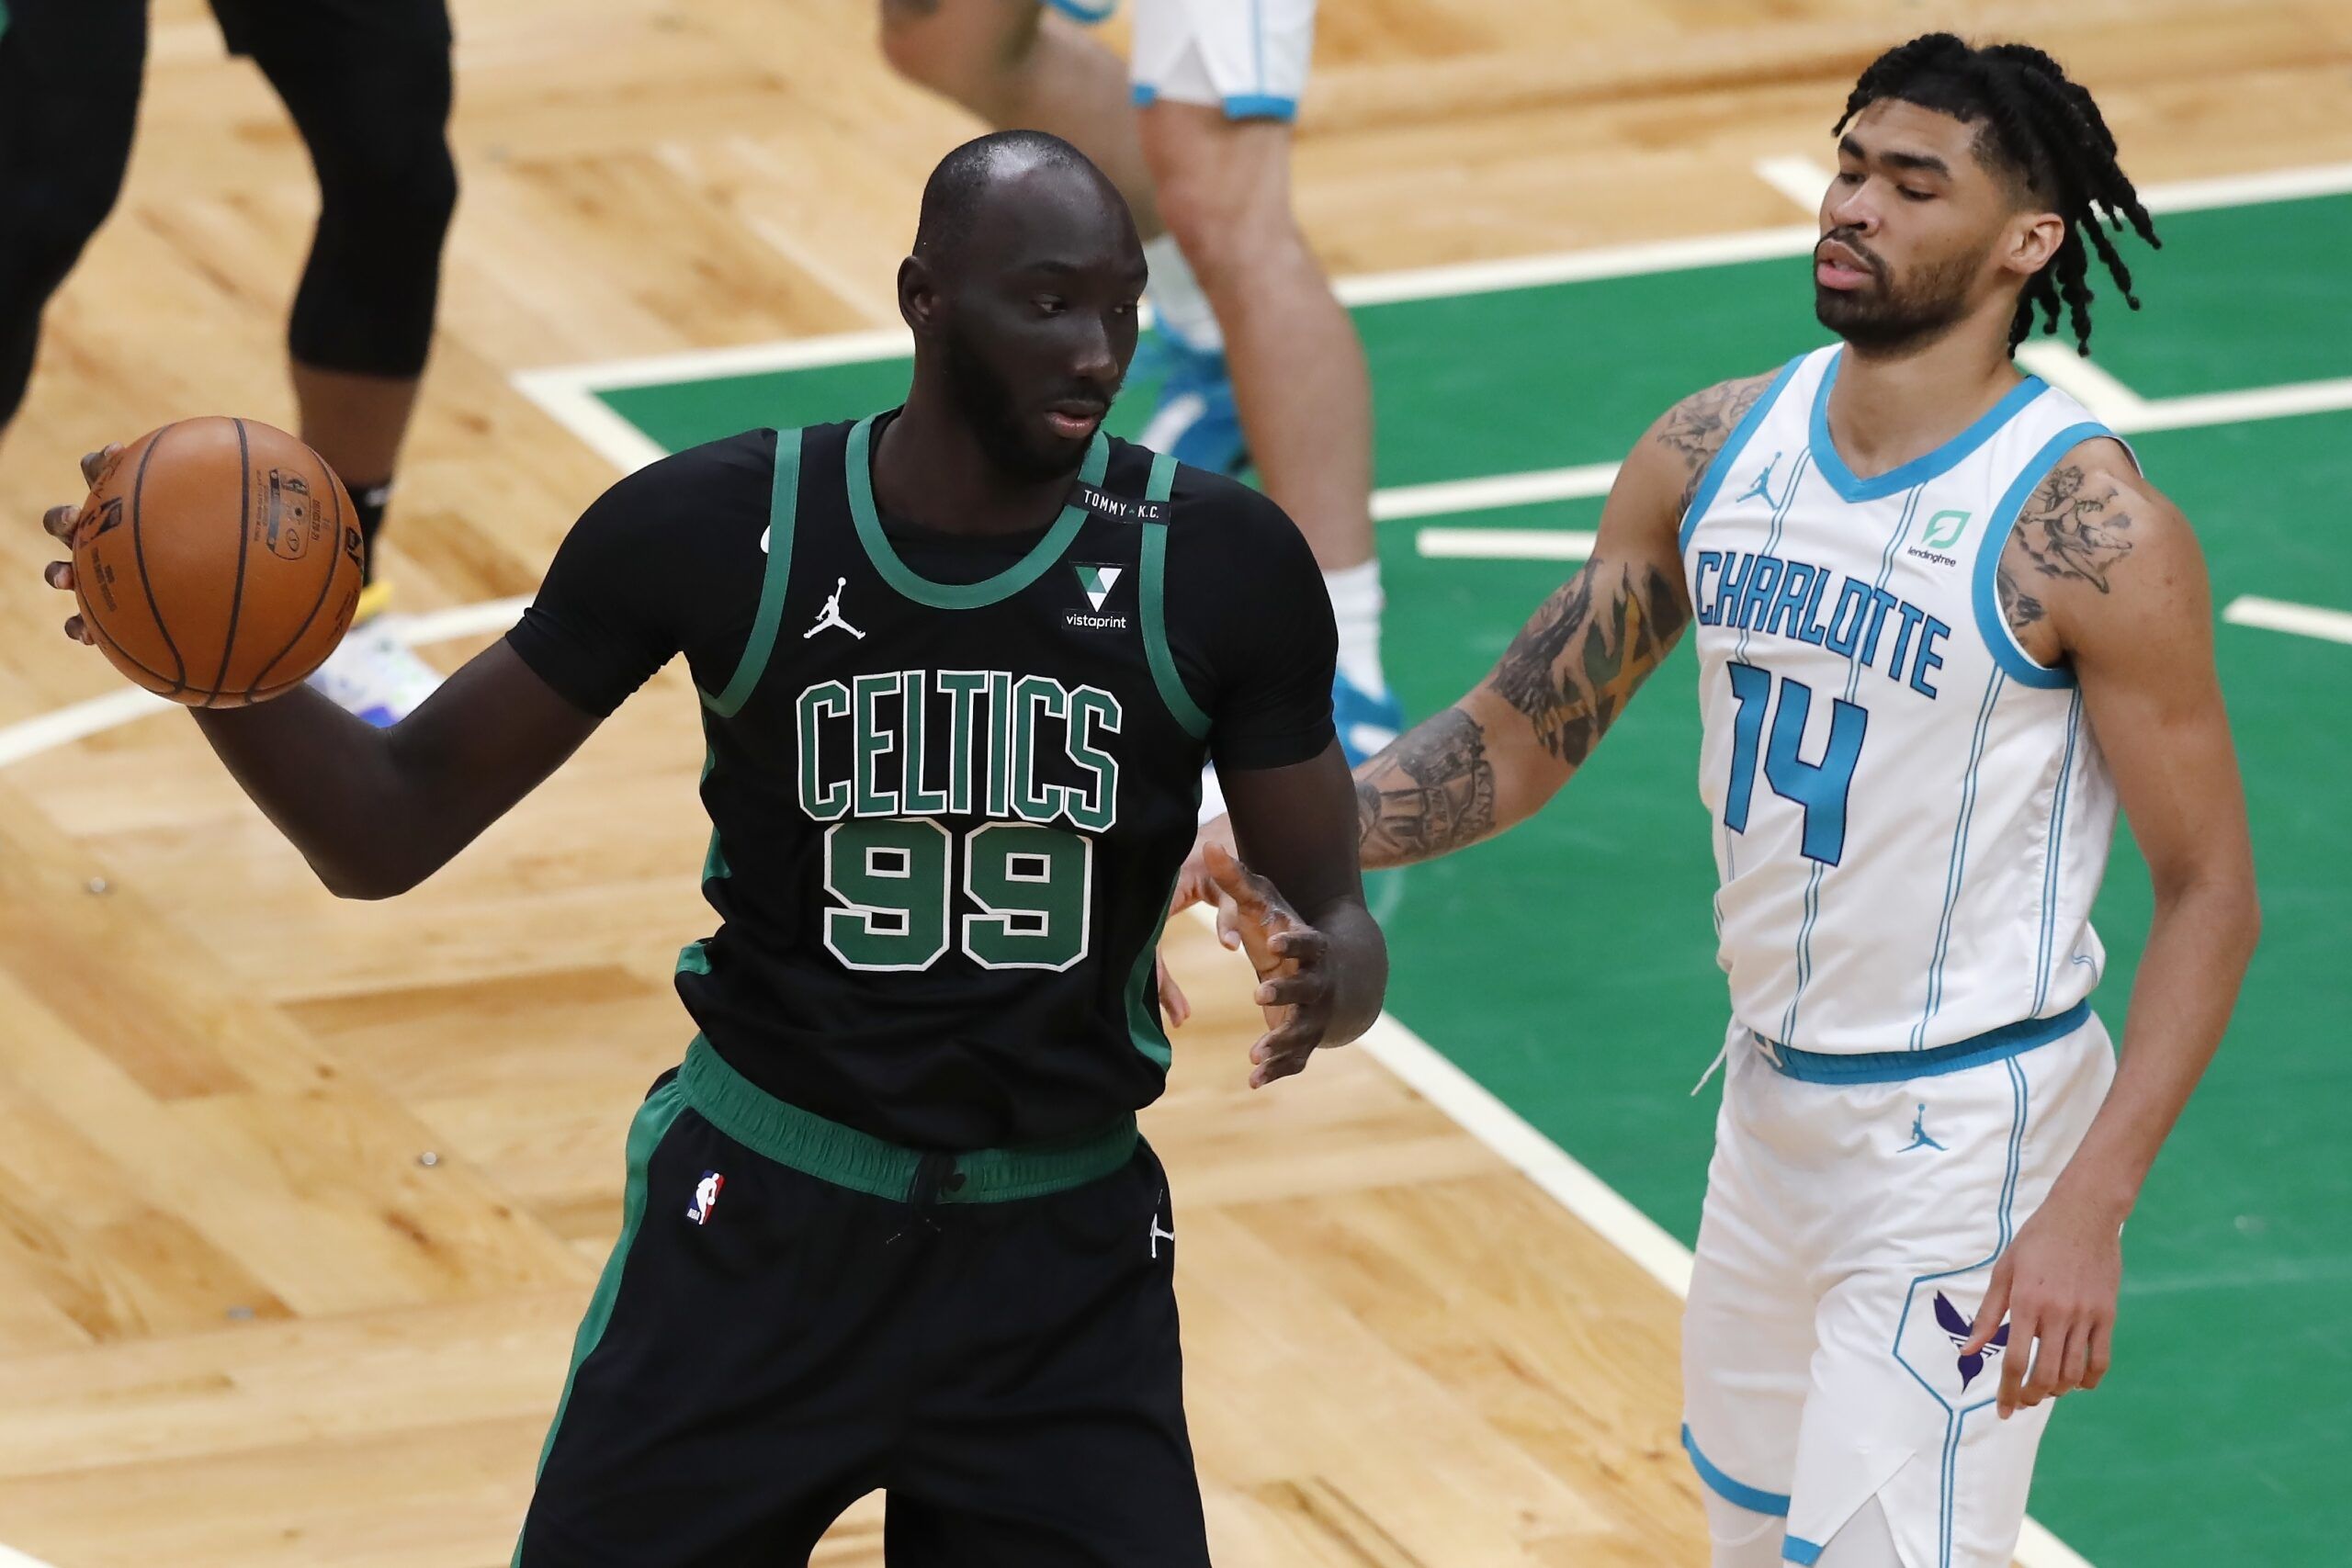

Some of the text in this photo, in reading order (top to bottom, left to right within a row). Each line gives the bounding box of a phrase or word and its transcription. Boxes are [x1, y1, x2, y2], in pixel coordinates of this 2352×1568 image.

[1084, 489, 1159, 519] TOMMY K.C.
[1907, 546, 1956, 567] lendingtree
[1066, 614, 1127, 629] vistaprint
[1695, 550, 1951, 700] CHARLOTTE
[796, 669, 1122, 833] CELTICS
[1724, 660, 1869, 867] 14
[823, 816, 1092, 973] 99
